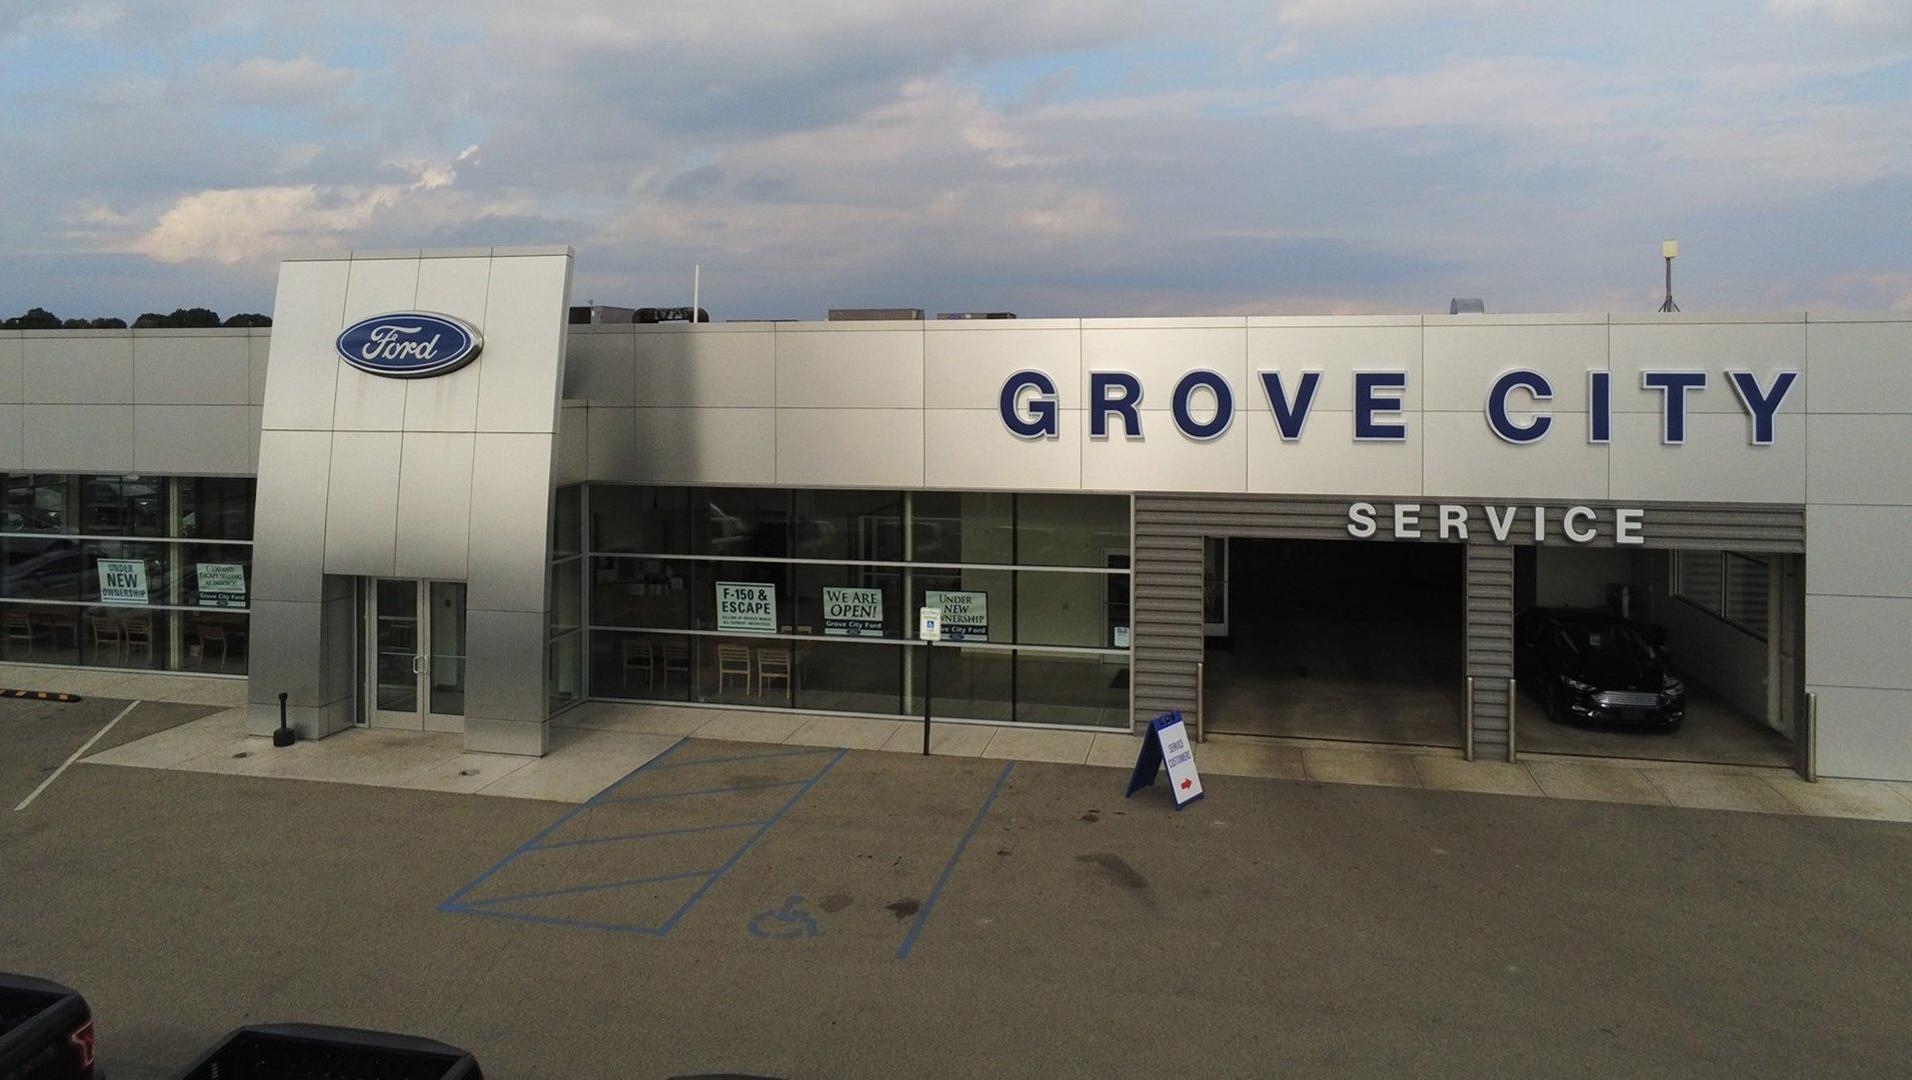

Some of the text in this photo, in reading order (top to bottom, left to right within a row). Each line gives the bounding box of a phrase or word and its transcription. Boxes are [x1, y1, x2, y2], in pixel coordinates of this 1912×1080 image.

[362, 325, 441, 360] Ford
[999, 367, 1799, 446] GROVE CITY
[1346, 502, 1645, 545] SERVICE
[108, 564, 134, 573] UNDER
[106, 573, 138, 588] NEW
[102, 588, 146, 598] OWNERSHIP
[723, 587, 768, 600] F-150 &
[721, 601, 771, 615] ESCAPE
[830, 604, 877, 618] OPEN!
[944, 604, 970, 614] NEW
[825, 620, 848, 628] Grove
[849, 621, 863, 629] City
[941, 614, 985, 624] NERSHIP
